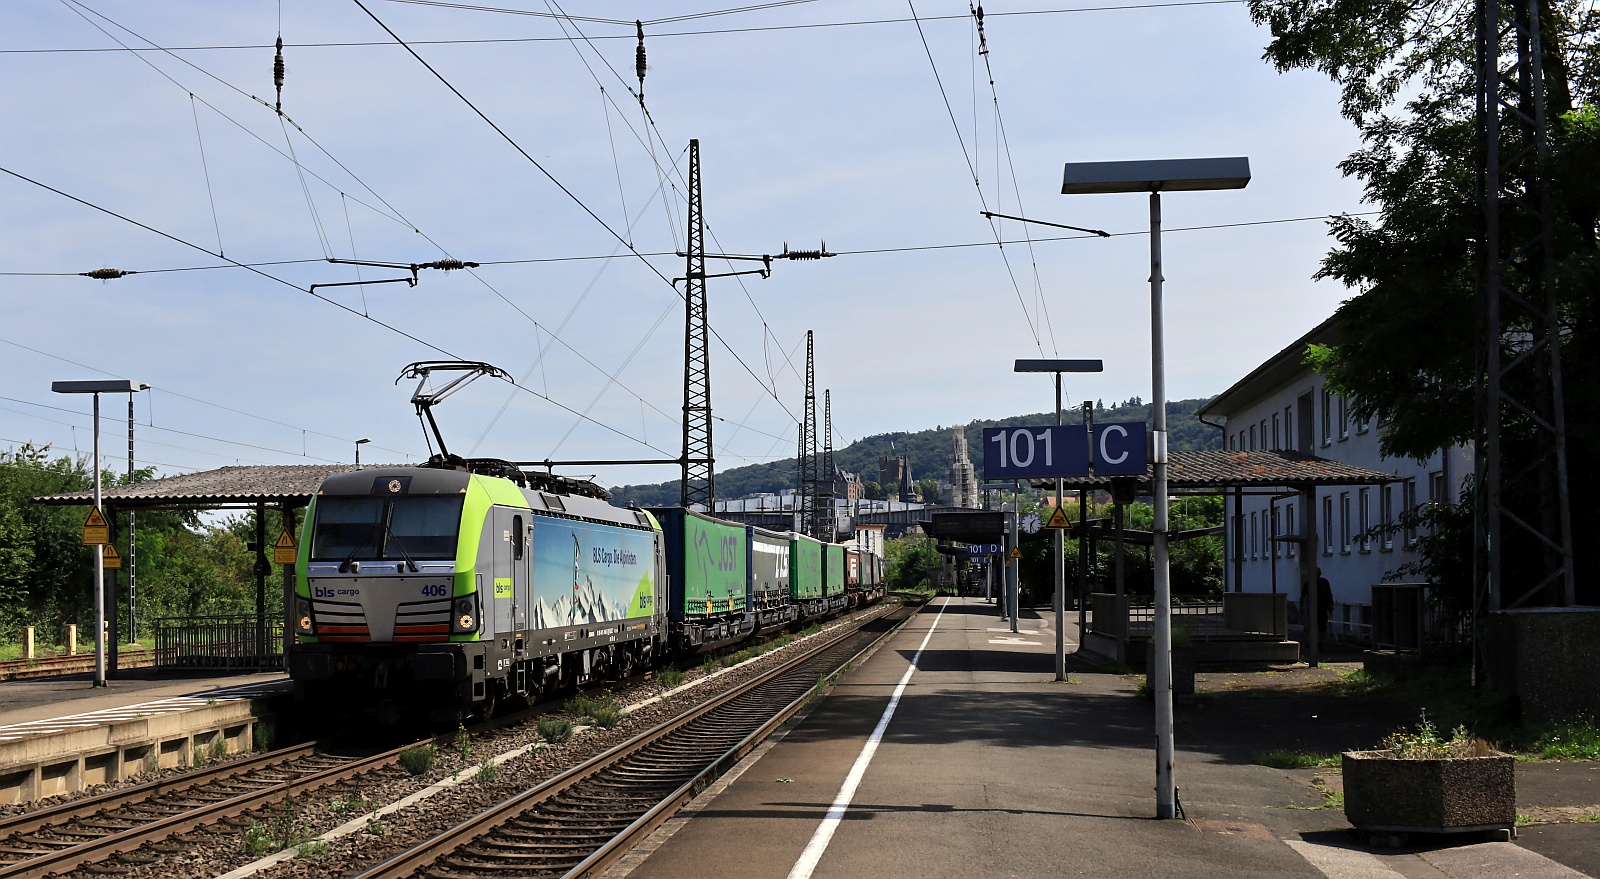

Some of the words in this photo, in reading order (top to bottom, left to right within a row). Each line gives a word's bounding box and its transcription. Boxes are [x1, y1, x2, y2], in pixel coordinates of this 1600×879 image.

[991, 428, 1053, 468] 101
[1099, 425, 1129, 465] C
[592, 547, 602, 564] BLS
[718, 535, 738, 572] JOST
[969, 545, 982, 554] 101
[990, 544, 997, 553] D
[315, 587, 335, 598] bls
[337, 588, 360, 597] cargo
[421, 584, 447, 597] 406
[639, 591, 647, 609] bls
